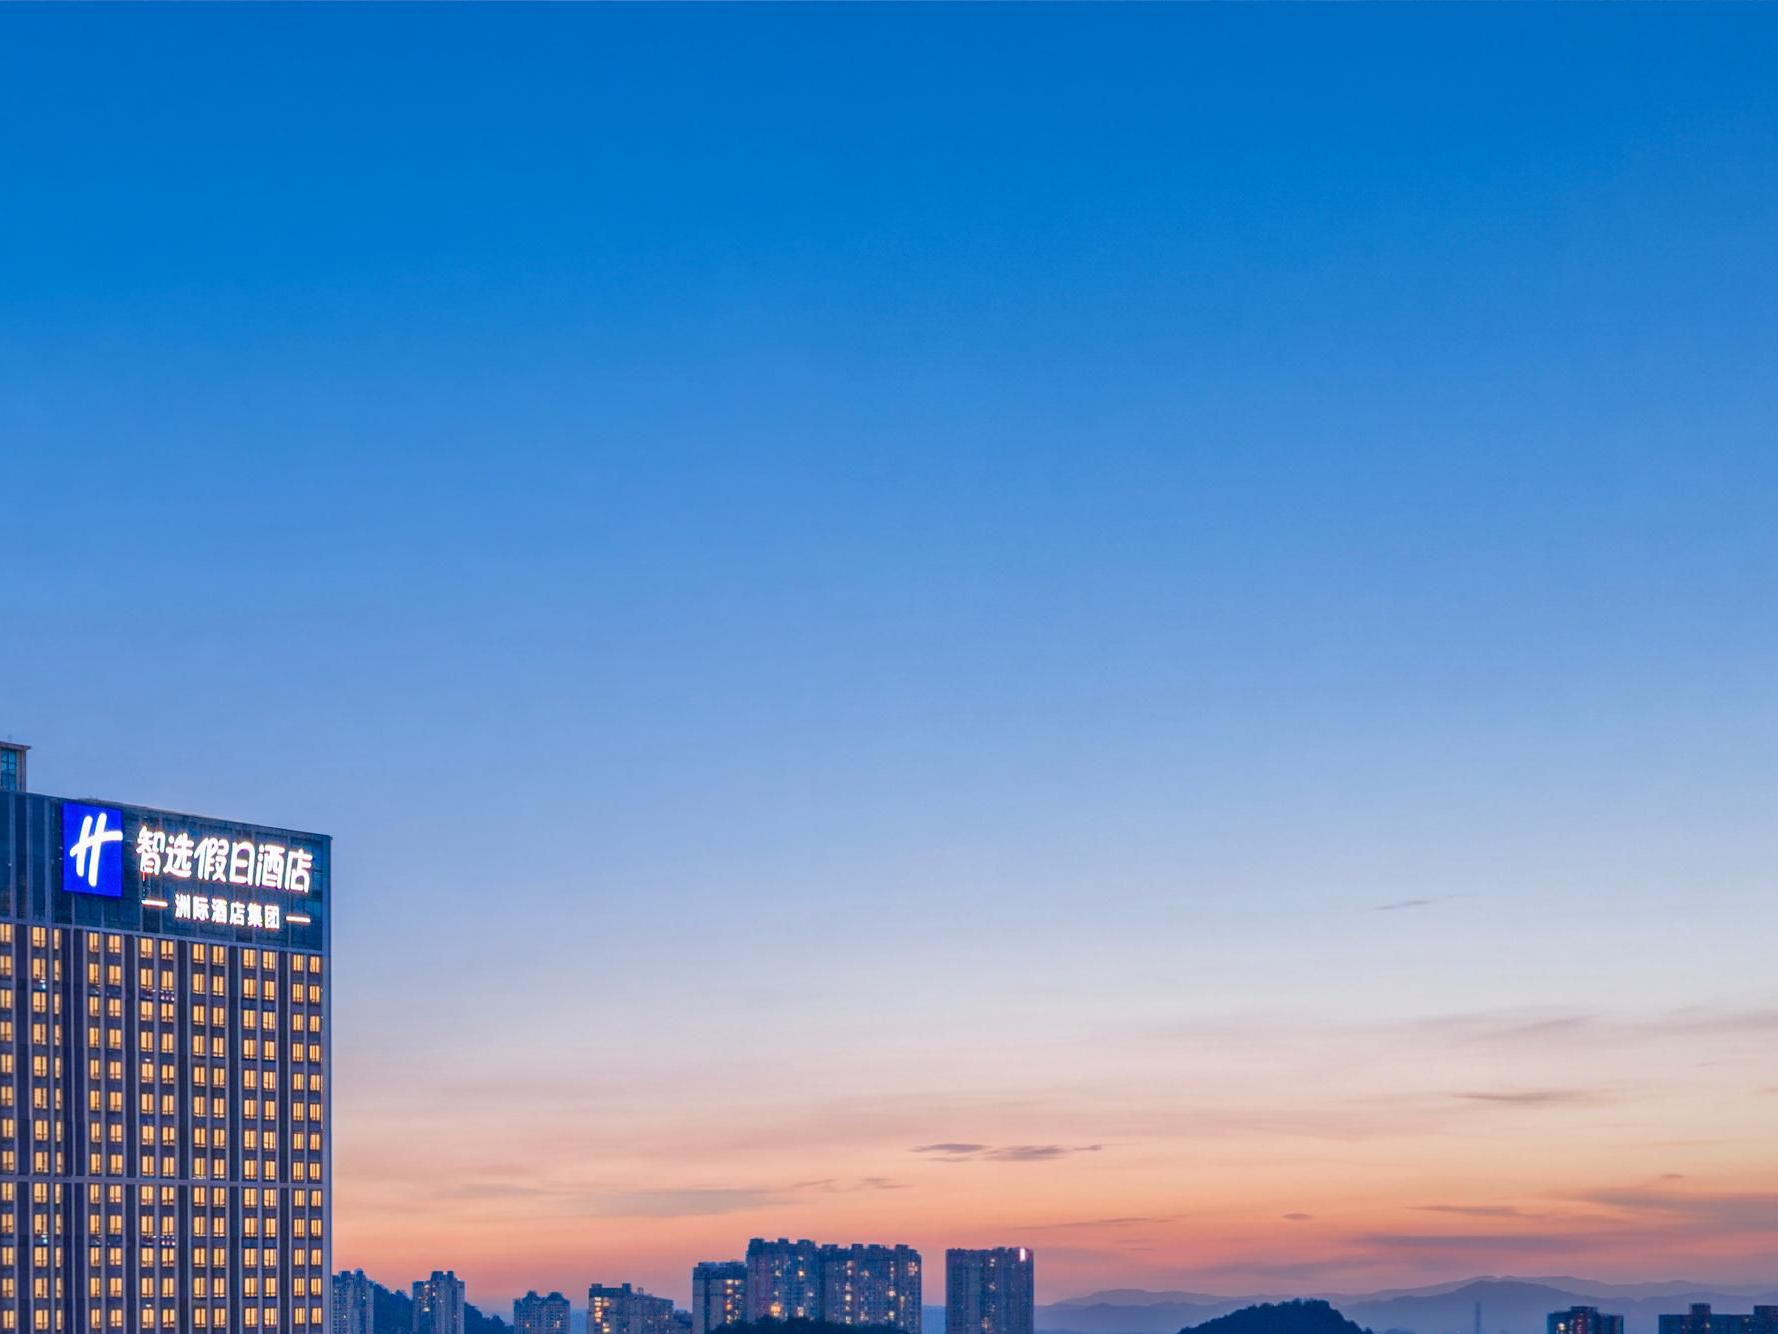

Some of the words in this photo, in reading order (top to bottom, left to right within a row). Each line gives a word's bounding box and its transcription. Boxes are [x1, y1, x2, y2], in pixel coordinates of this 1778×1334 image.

[136, 825, 313, 893] 智选假日酒店
[175, 894, 281, 930] 洲际酒店集团
